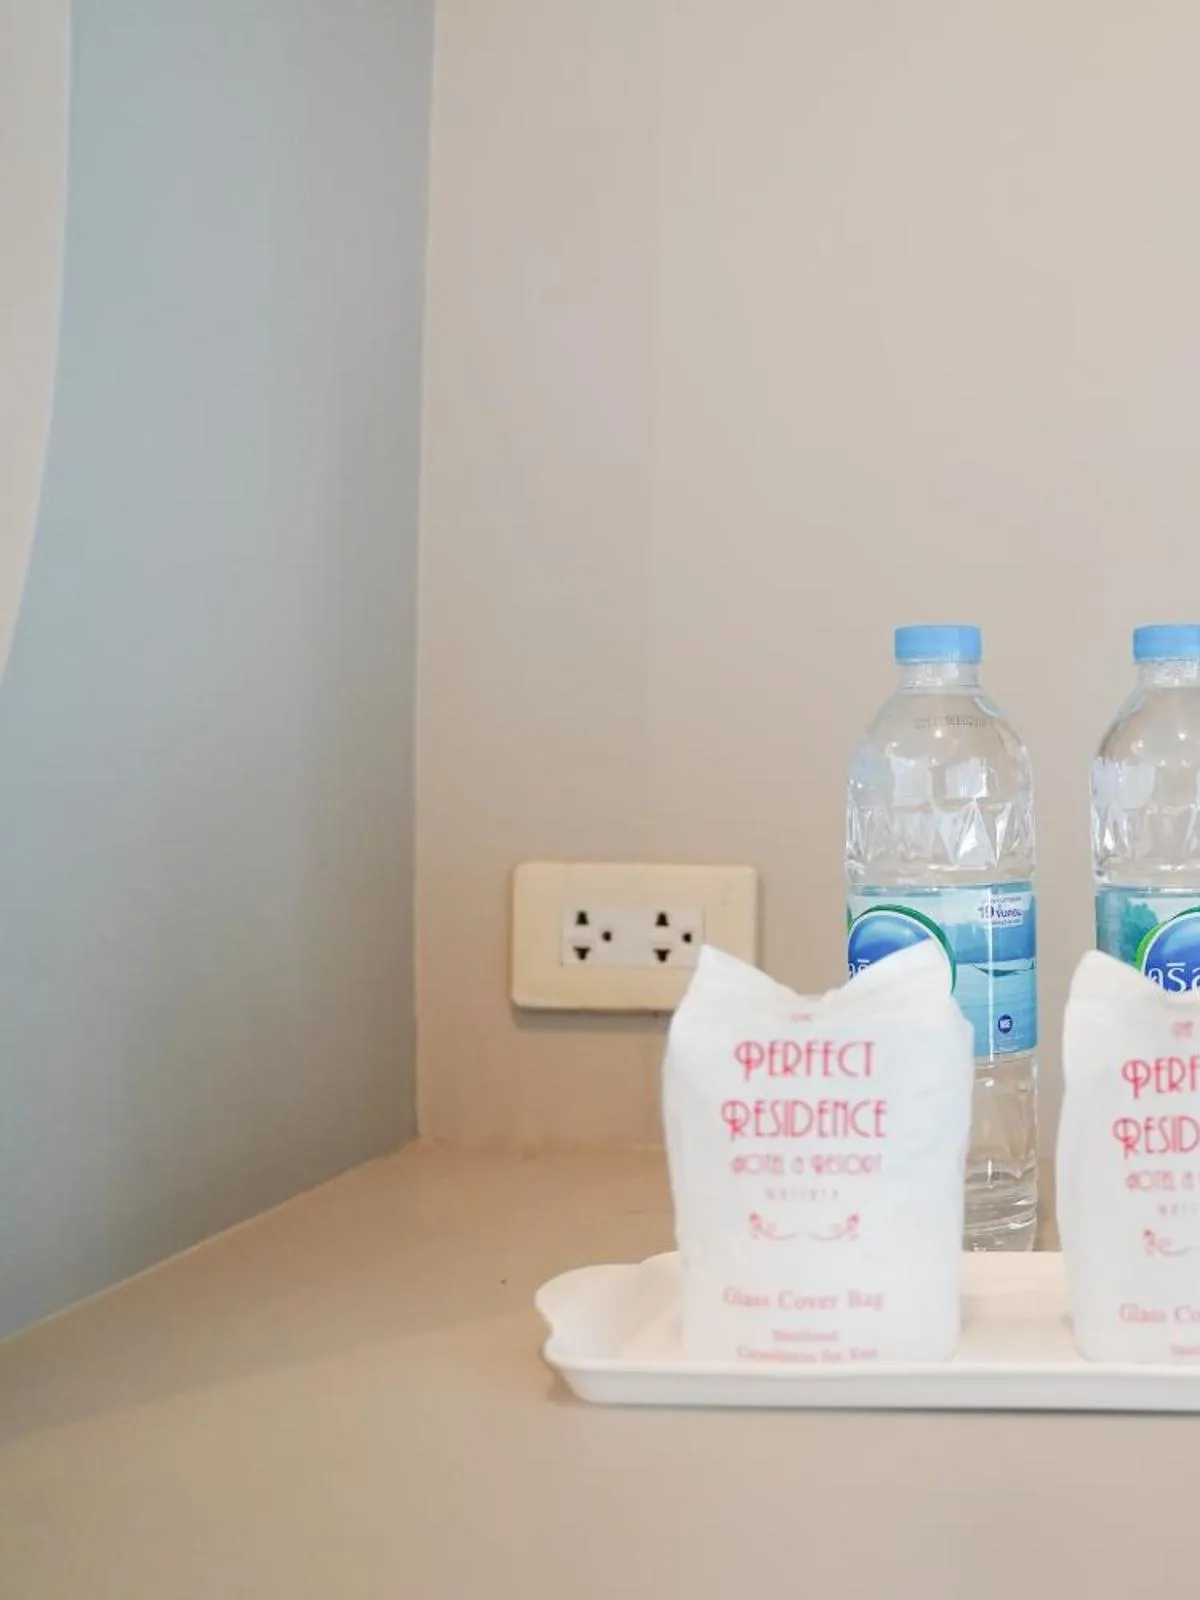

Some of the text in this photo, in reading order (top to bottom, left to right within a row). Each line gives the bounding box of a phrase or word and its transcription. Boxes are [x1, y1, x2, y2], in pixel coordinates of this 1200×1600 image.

[733, 1039, 875, 1082] PERFECT
[721, 1100, 888, 1141] RESIDENCE
[777, 1290, 838, 1310] Cover
[847, 1289, 884, 1311] Bag
[1118, 1303, 1167, 1324] Glass
